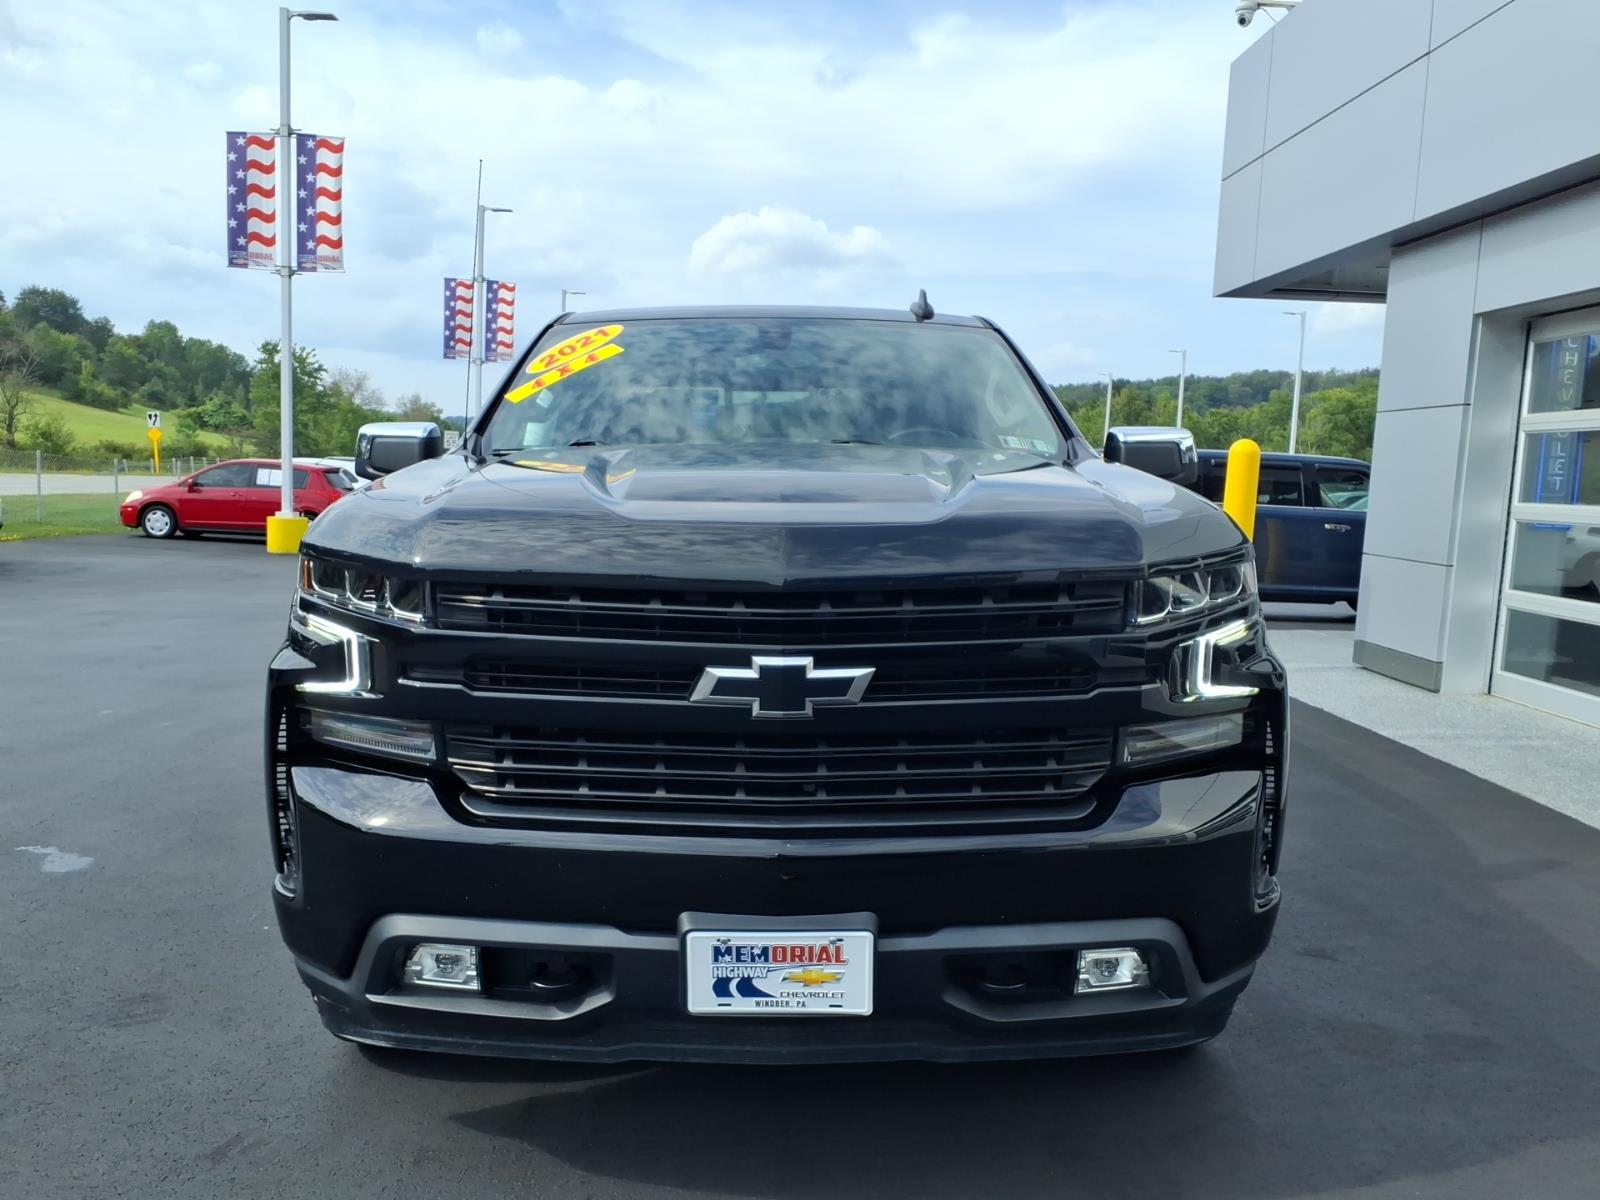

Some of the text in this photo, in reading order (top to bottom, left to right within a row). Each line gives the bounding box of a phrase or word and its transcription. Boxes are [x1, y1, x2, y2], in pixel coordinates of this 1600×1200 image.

[539, 328, 609, 368] 2021
[1552, 337, 1579, 491] CHEVLET
[711, 944, 848, 965] MEMORIAL
[712, 966, 769, 979] HIGHWAY
[780, 991, 846, 999] CHEVROLET
[755, 1000, 807, 1008] WINDBER, PA
